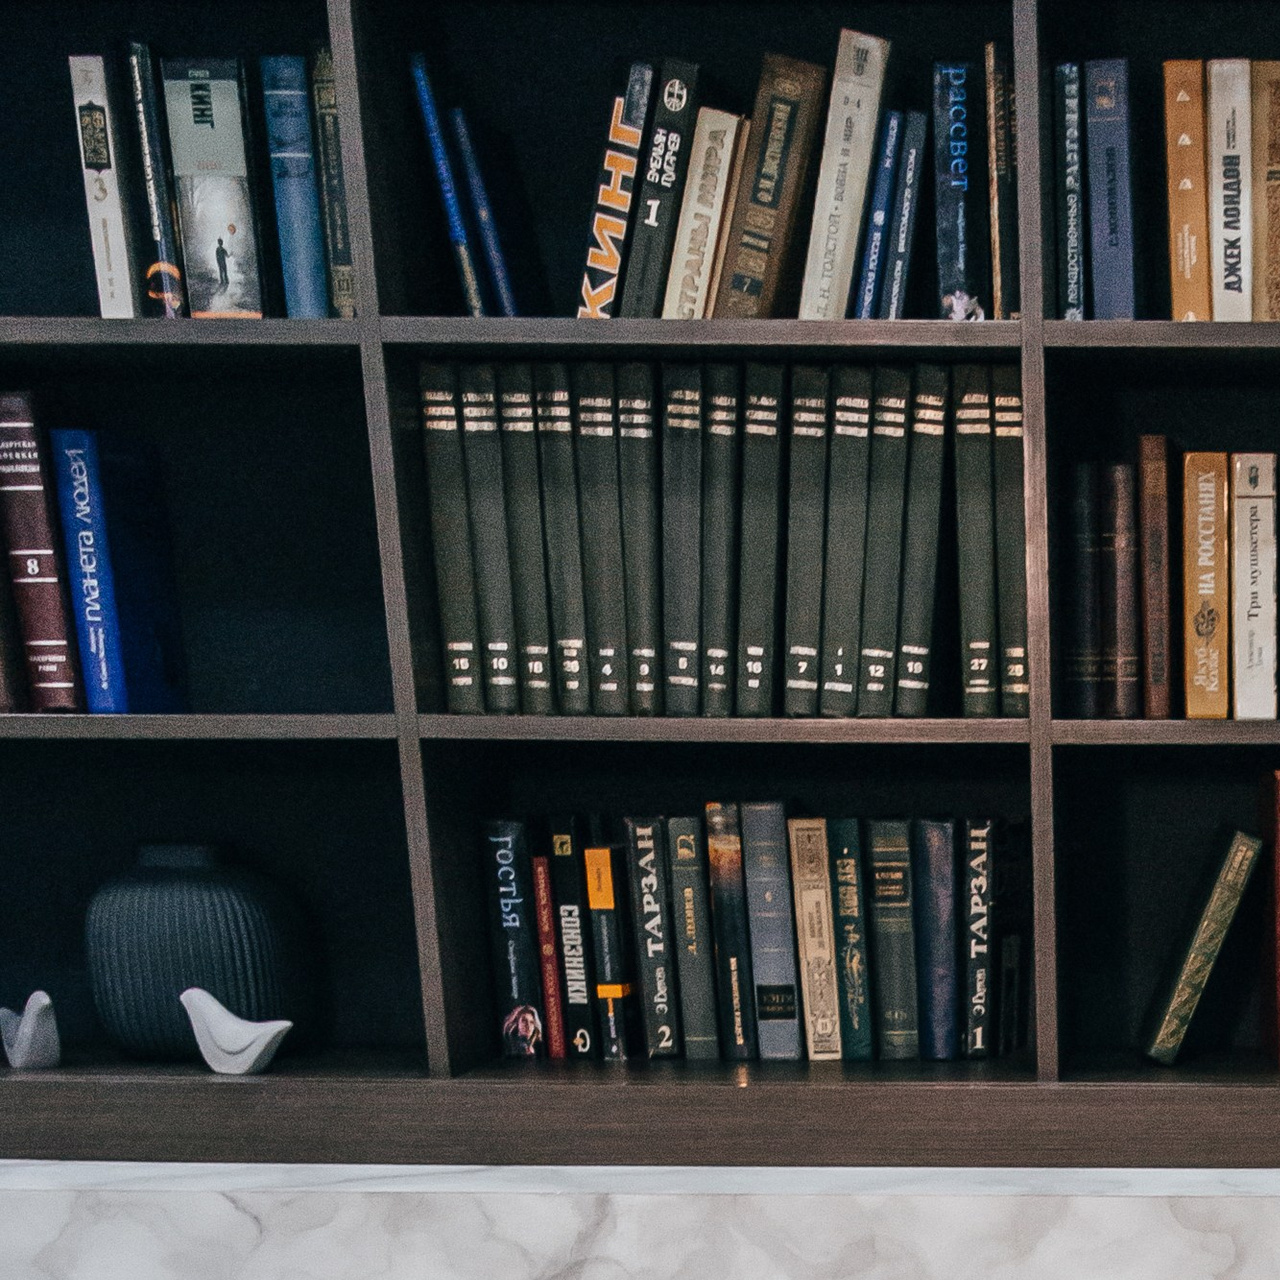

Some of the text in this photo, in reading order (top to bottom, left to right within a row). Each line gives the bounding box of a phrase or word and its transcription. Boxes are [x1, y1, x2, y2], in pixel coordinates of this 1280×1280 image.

[940, 66, 969, 192] рассвет
[697, 129, 727, 209] МИРА
[823, 212, 841, 283] ТОЛСТОЙ
[834, 161, 848, 203] ВОЙНА
[844, 116, 855, 142] МИР
[1065, 83, 1080, 305] лекарственные РАСТЕНИЯ
[577, 97, 643, 319] КИНГ
[644, 199, 660, 227] 1
[1222, 155, 1243, 294] ДЖЕК ЛОНДОН
[65, 447, 102, 622] планета людей
[1197, 472, 1217, 596] НА РОССТАНЯХ
[1247, 505, 1263, 622] Три мушкетера
[26, 558, 39, 576] 8
[491, 657, 509, 671] 10
[601, 664, 613, 677] 4
[798, 661, 808, 674] 7
[834, 663, 843, 676] 1
[869, 665, 885, 678] 12
[969, 658, 988, 671] 27
[1193, 647, 1208, 687] Якуб
[1205, 651, 1220, 693] Колас
[636, 825, 665, 958] ТАРЗАН
[969, 827, 989, 959] ТАРЗАН
[560, 905, 588, 1004] СОЮЗНИКИ
[658, 1025, 673, 1049] 2
[972, 1026, 984, 1050] 1
